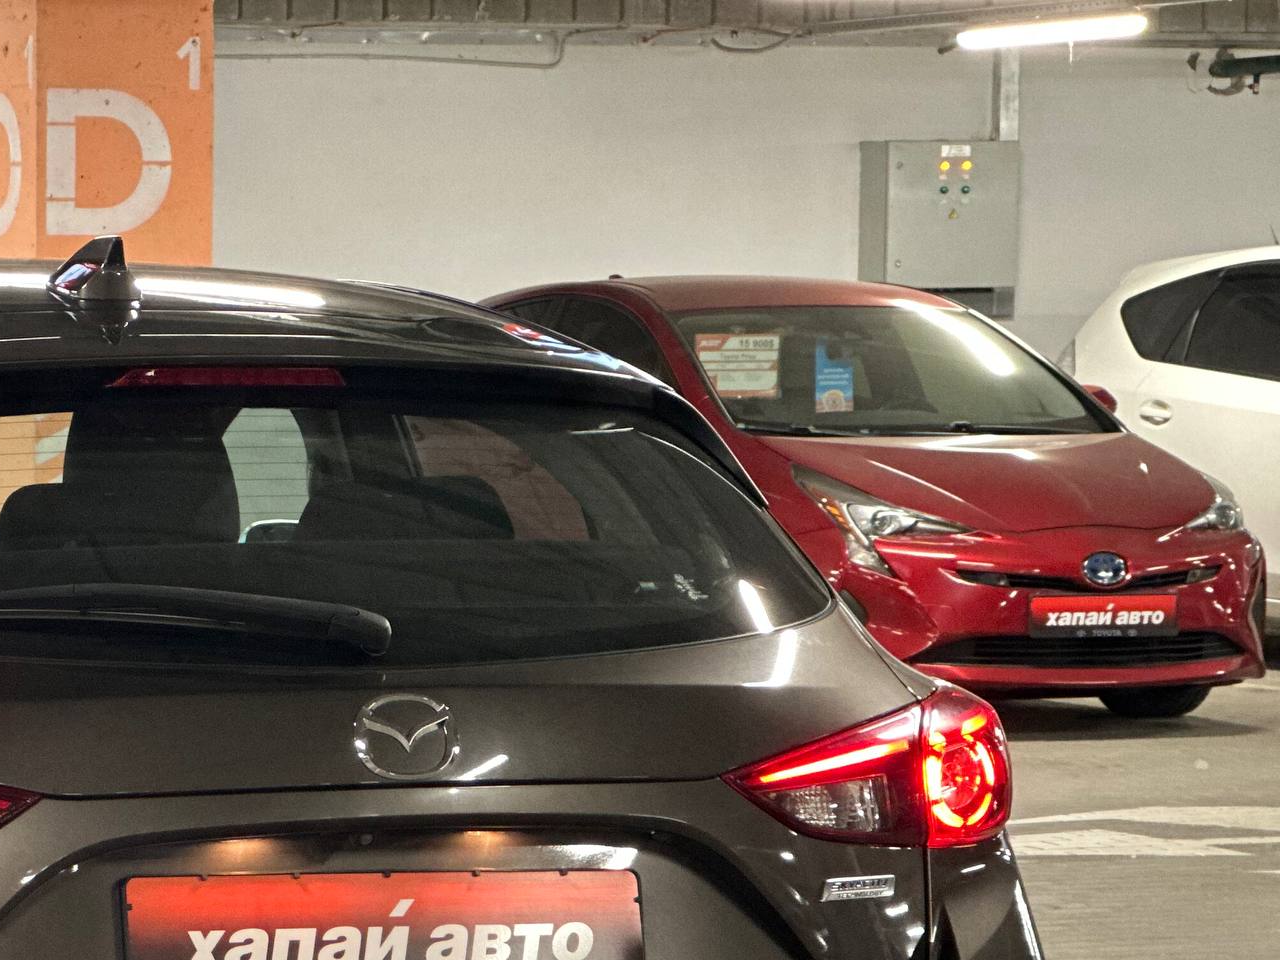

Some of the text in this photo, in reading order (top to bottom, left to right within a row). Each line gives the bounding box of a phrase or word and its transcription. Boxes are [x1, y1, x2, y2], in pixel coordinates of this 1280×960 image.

[24, 34, 34, 90] 1
[176, 36, 201, 90] 1
[45, 87, 172, 236] D
[1046, 603, 1165, 626] хапай авто
[1092, 629, 1122, 637] TOYOTA
